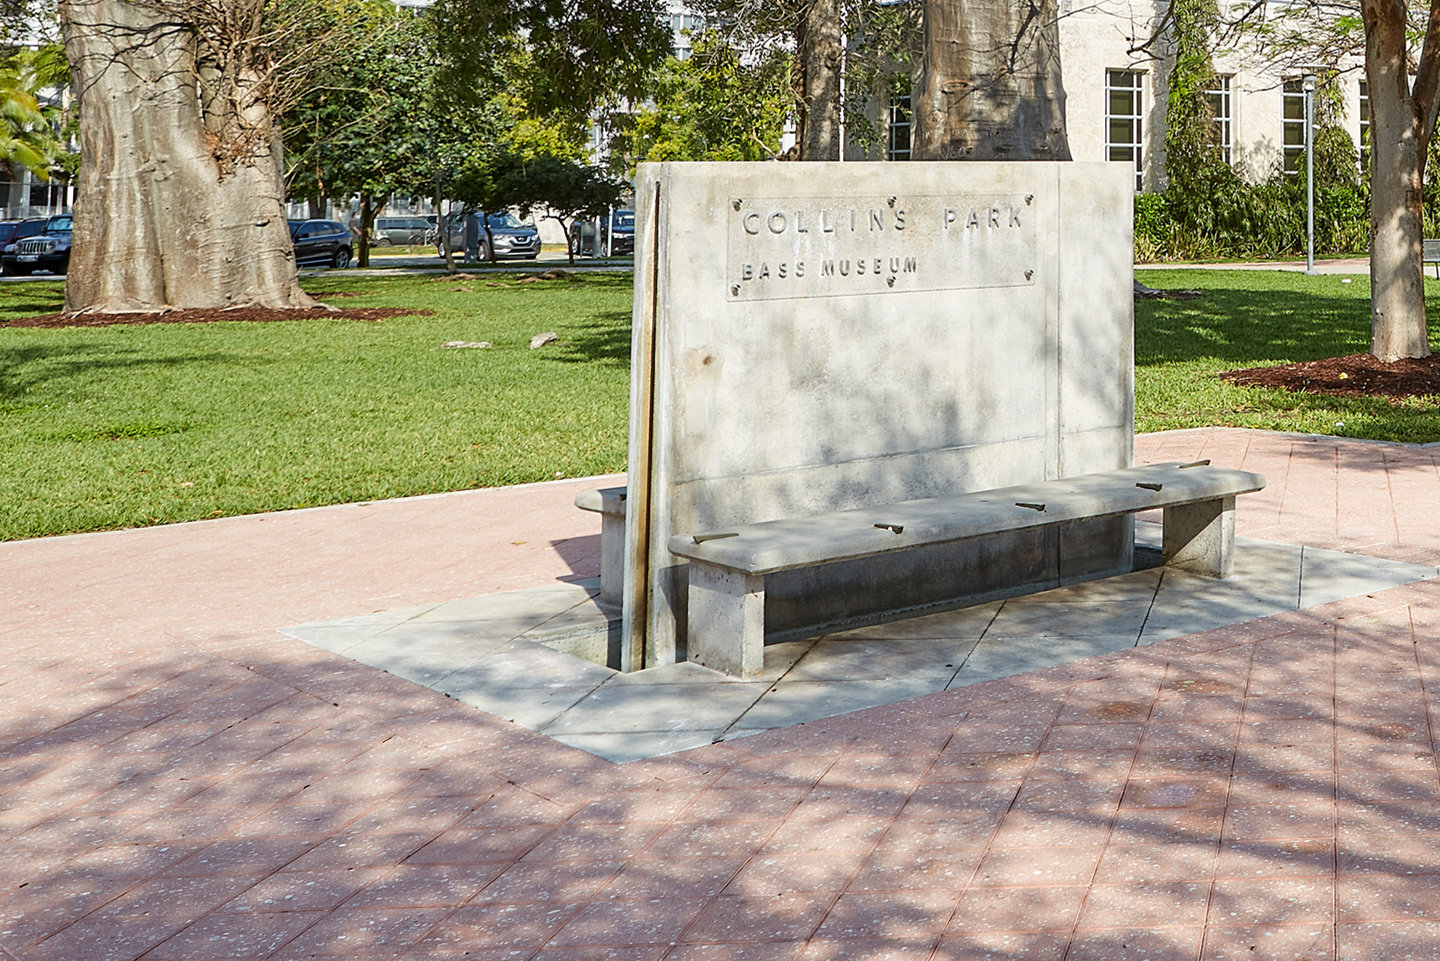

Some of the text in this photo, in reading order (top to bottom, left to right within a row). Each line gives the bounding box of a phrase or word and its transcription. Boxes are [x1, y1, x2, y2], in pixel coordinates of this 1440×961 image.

[743, 206, 1021, 235] COLLINS PARK
[742, 257, 916, 280] BASS MUSEUM
